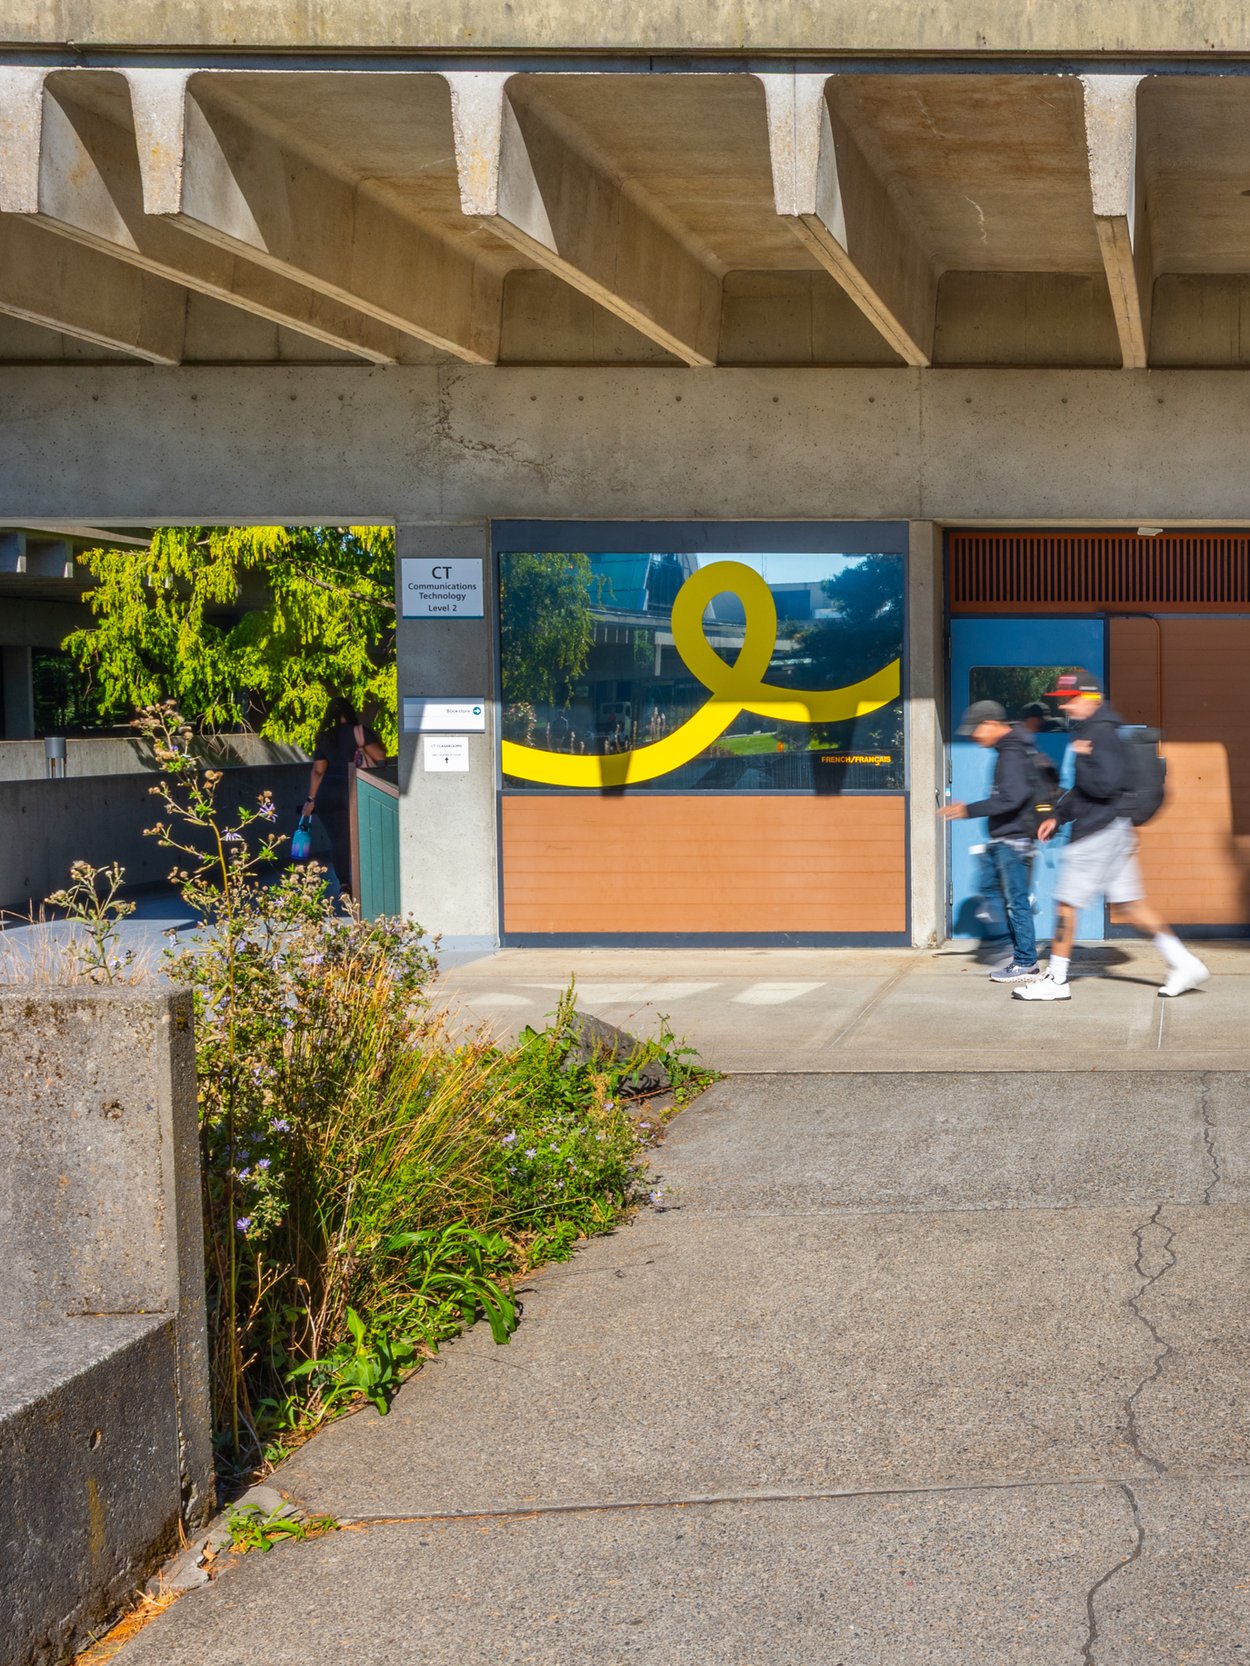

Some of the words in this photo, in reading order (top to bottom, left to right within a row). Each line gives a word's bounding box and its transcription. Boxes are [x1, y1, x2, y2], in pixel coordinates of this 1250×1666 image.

[431, 566, 452, 580] CT
[407, 582, 477, 591] Communications
[419, 592, 467, 602] Technology
[428, 604, 450, 612] Level
[452, 604, 458, 612] 2
[821, 755, 892, 766] FRENCH/FRANÇAIS
